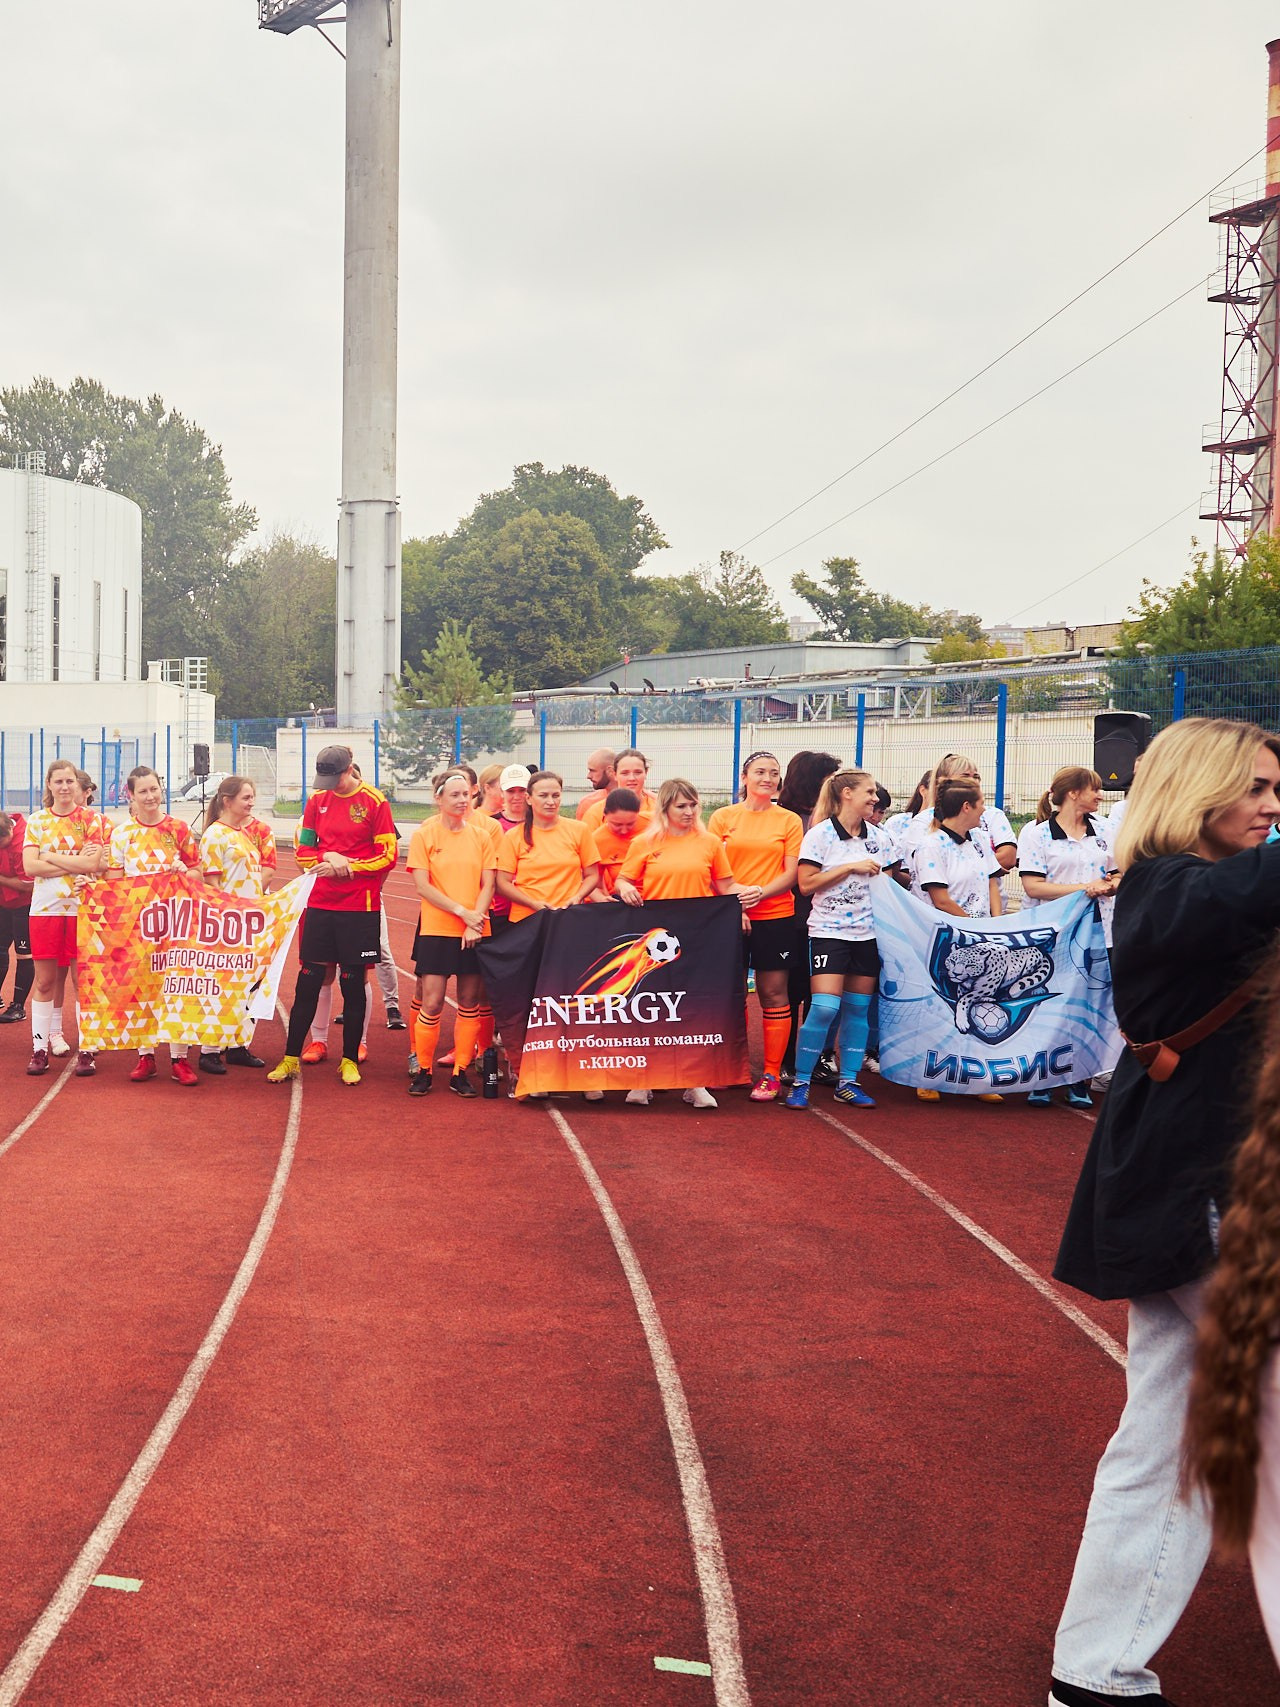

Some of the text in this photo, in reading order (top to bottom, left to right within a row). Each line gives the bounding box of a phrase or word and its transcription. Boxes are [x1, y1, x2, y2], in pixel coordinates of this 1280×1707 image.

[197, 899, 265, 947] БОР
[151, 949, 254, 972] НИЕГОРОДСКАЯ
[813, 954, 829, 969] 37
[526, 990, 687, 1029] ENERGY
[557, 1034, 651, 1052] футбольная
[653, 1032, 724, 1047] команда
[578, 1055, 648, 1070] г.КИРОВ
[923, 1044, 1074, 1088] ИРБИС
